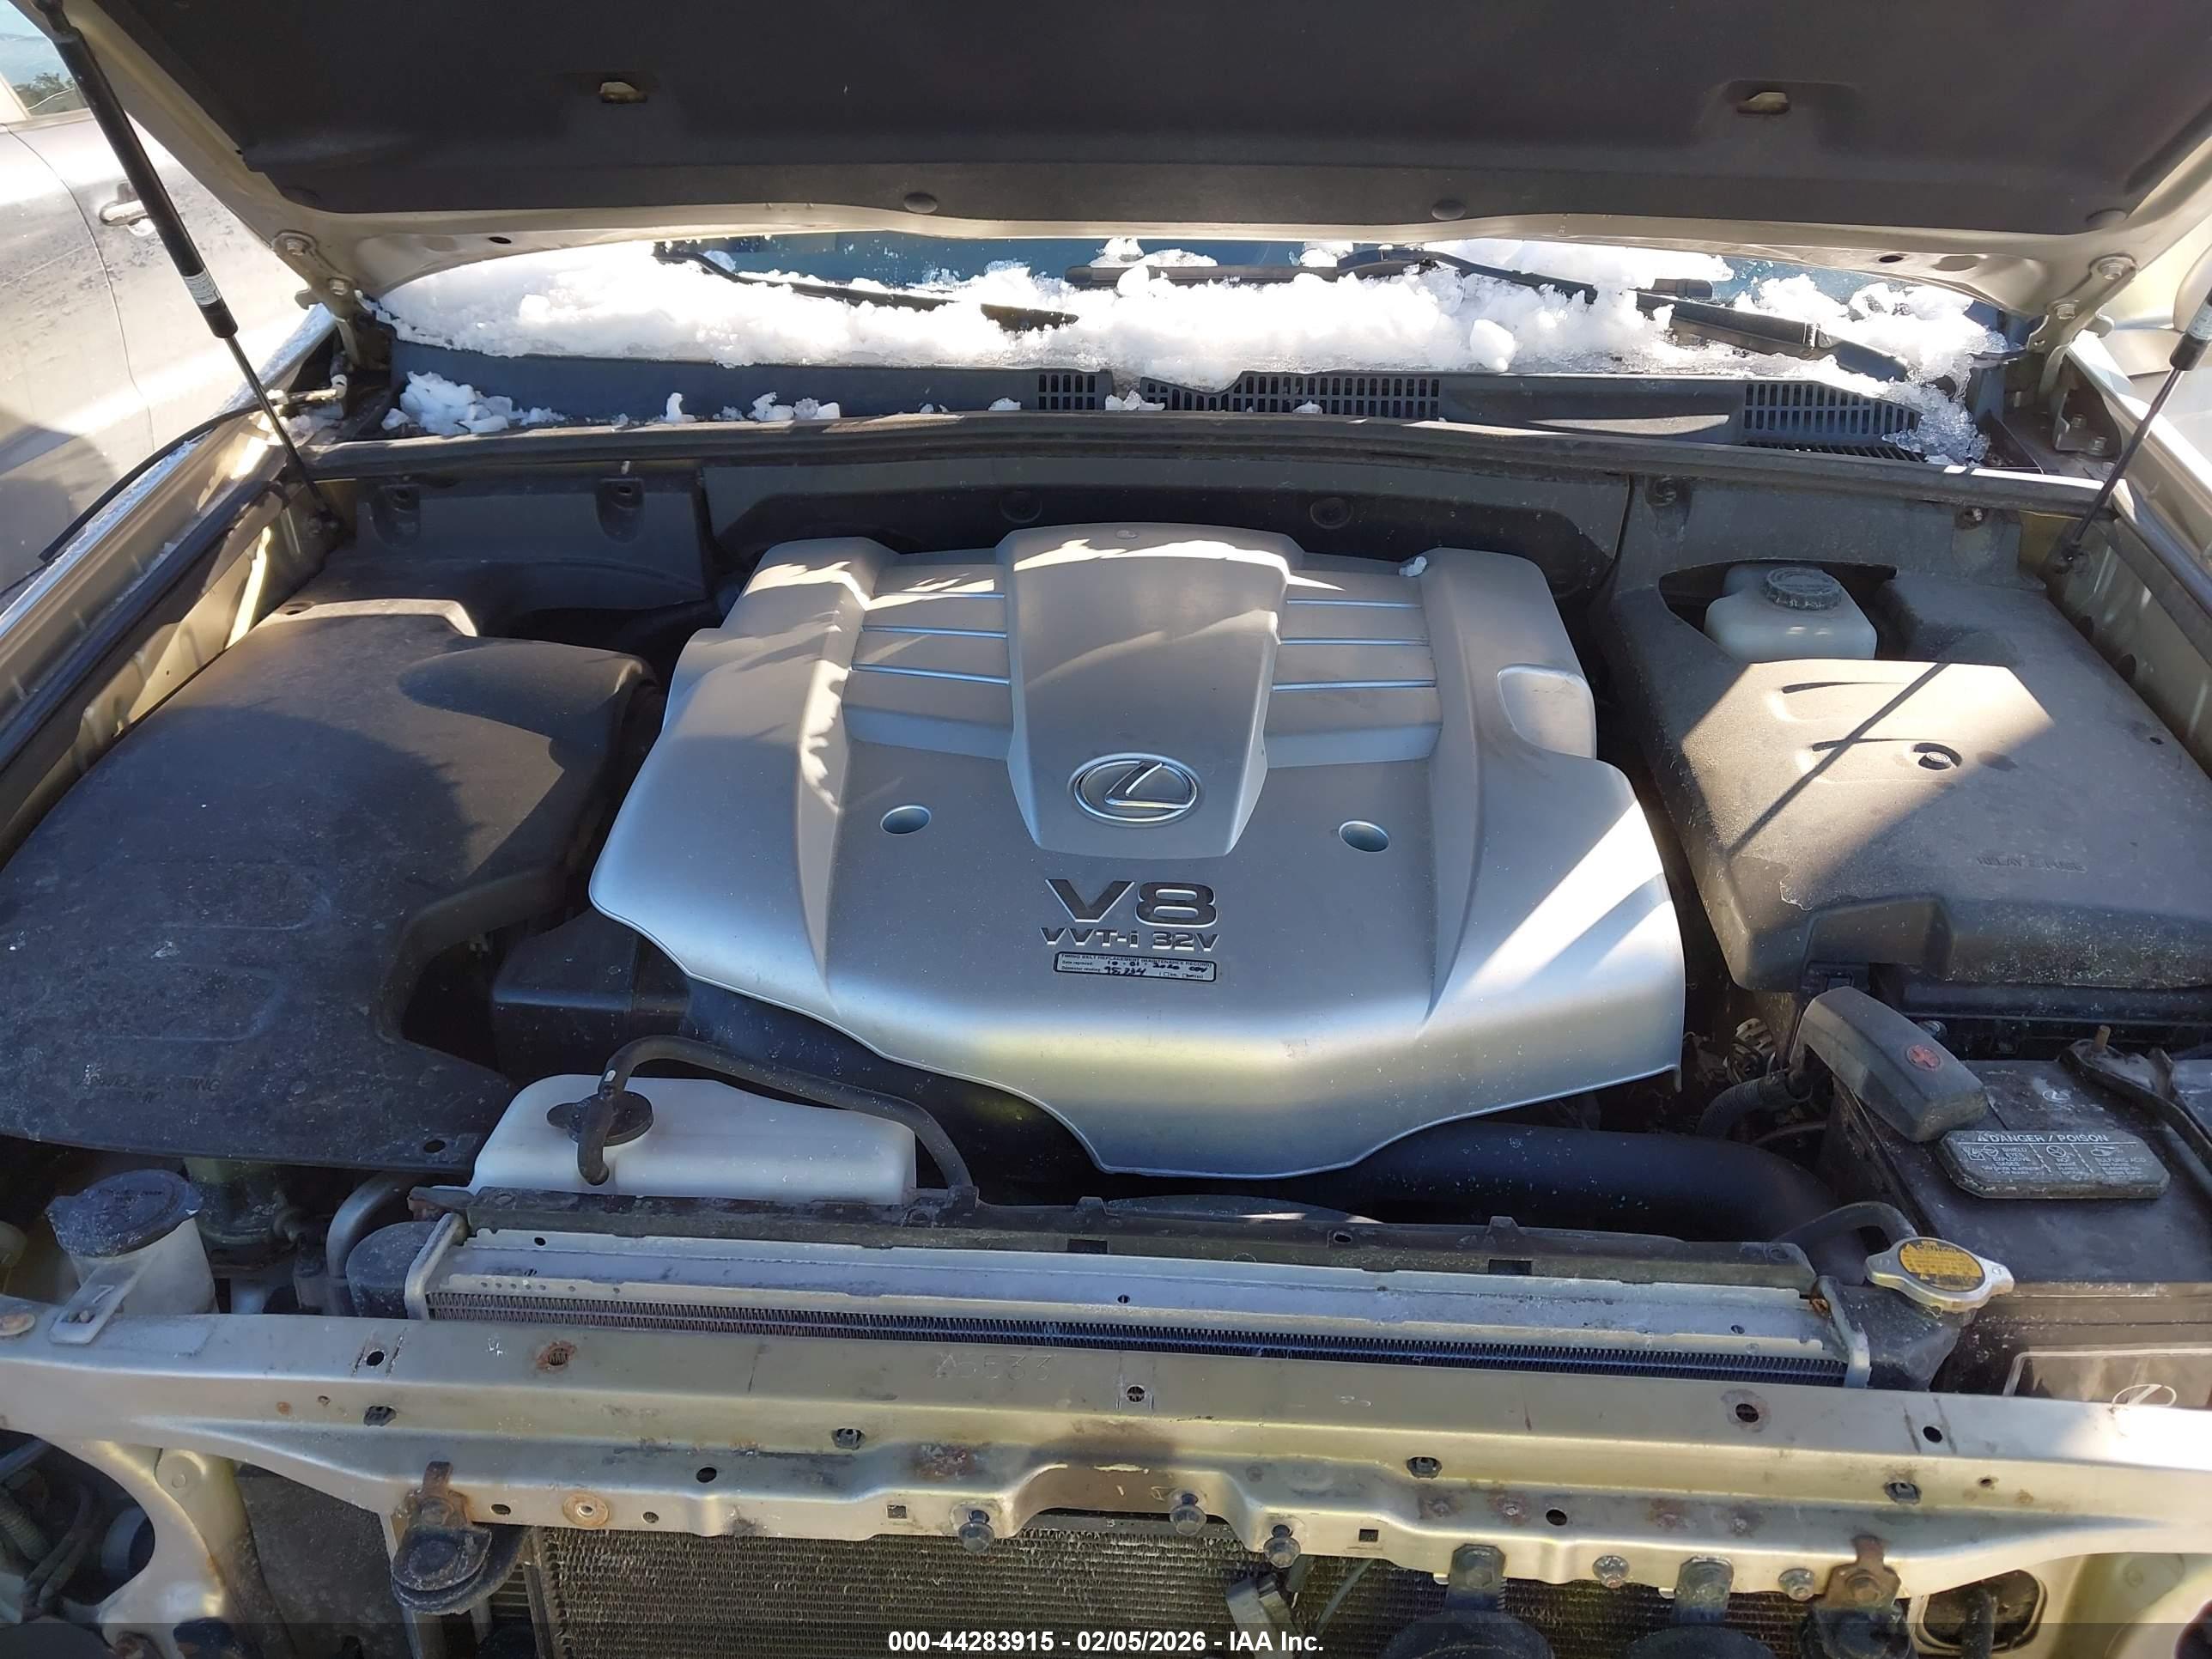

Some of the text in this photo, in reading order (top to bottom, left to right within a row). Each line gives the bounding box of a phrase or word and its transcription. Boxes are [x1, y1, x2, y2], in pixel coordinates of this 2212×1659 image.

[1045, 878, 1218, 928] V8
[1040, 927, 1219, 951] VVT-i 32V
[1989, 1133, 2045, 1142] DANGER
[2057, 1134, 2110, 1143] POISON
